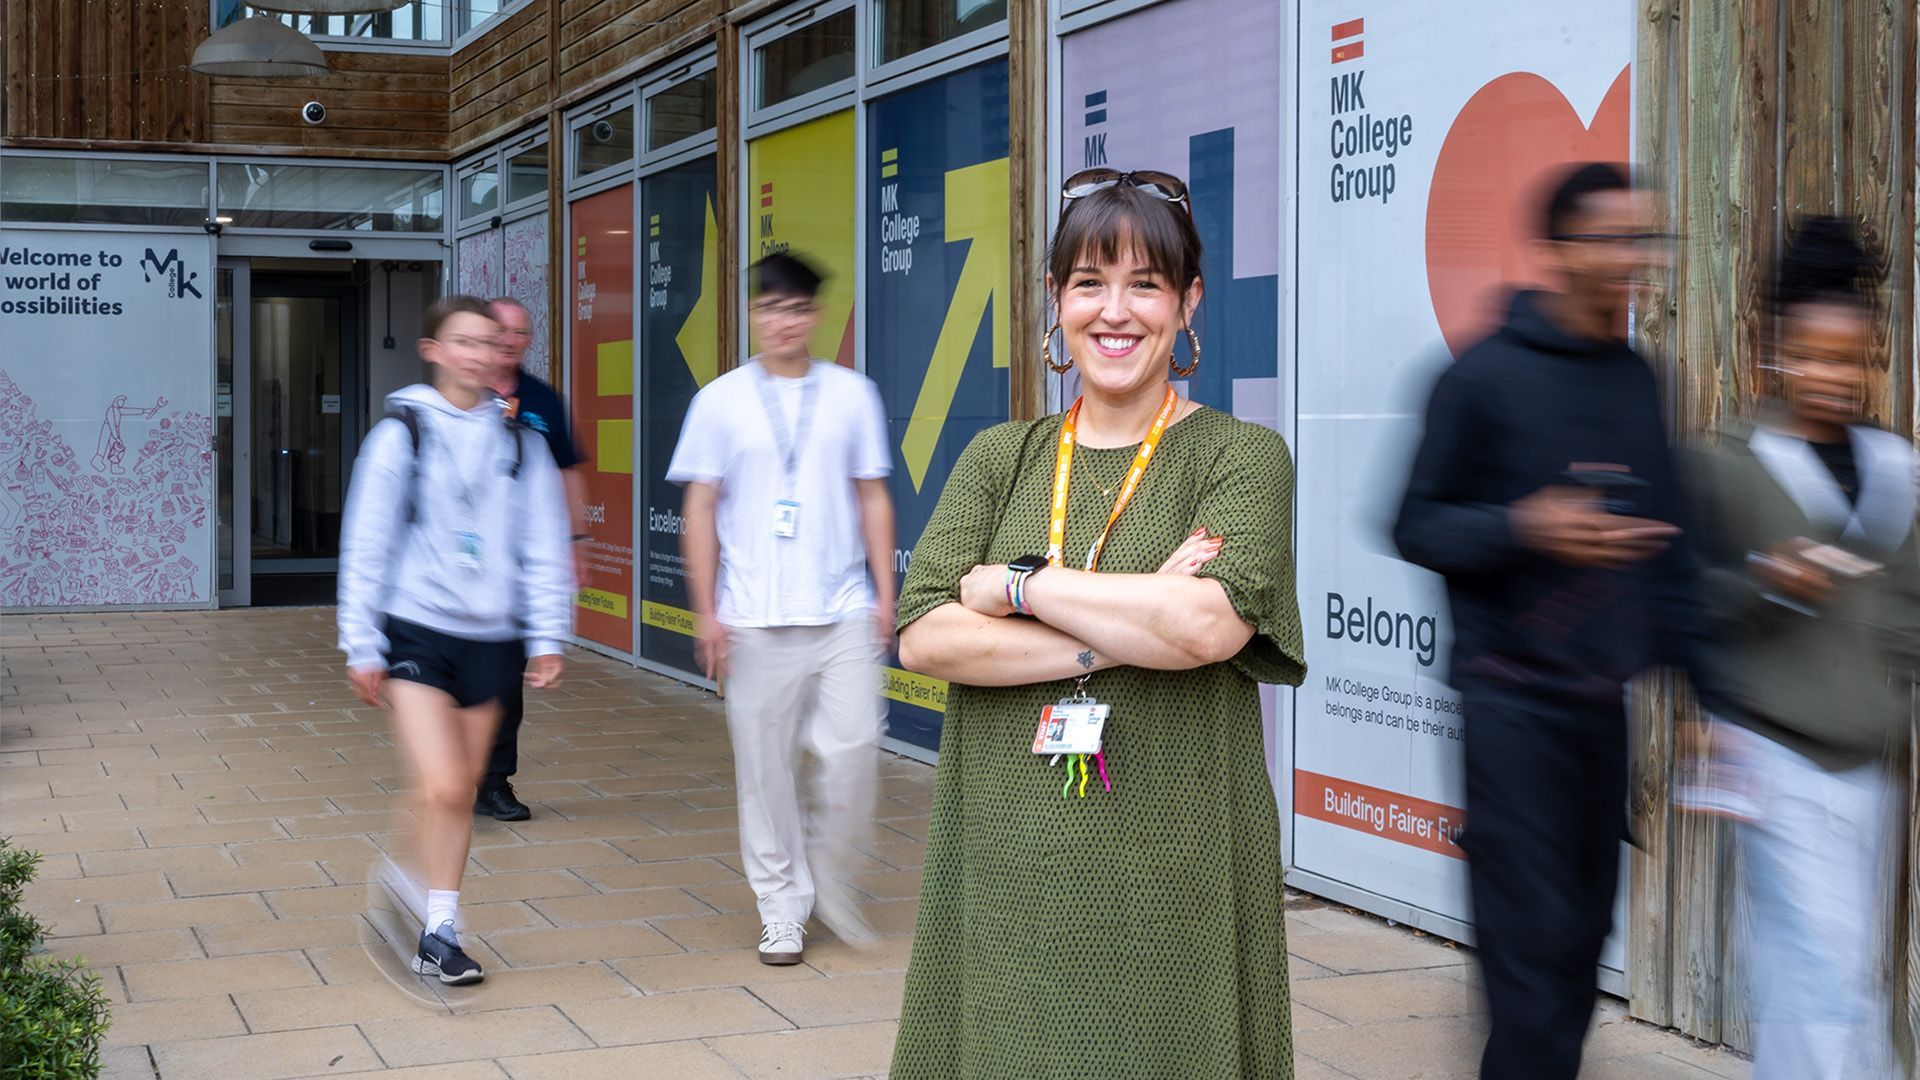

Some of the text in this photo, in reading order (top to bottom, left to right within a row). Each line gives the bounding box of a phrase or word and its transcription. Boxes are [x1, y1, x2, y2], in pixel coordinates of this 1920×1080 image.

[1331, 70, 1365, 116] MK
[1085, 132, 1107, 168] MK
[1330, 113, 1412, 159] College
[881, 183, 899, 214] MK
[1330, 162, 1396, 204] Group
[760, 213, 774, 238] MK
[881, 213, 920, 245] College
[98, 250, 123, 268] to
[881, 246, 912, 276] Group
[5, 272, 101, 291] world of
[168, 267, 176, 299] College
[650, 263, 671, 287] College
[1, 296, 123, 315] ossibilities
[650, 287, 668, 311] Group
[649, 507, 688, 535] Excellenc
[1326, 592, 1437, 667] Belong
[882, 672, 910, 699] Building
[911, 680, 931, 700] Fairer
[1326, 675, 1463, 716] MK College Group is a place
[1325, 700, 1363, 723] belongs
[1365, 710, 1384, 725] and
[1385, 713, 1404, 729] can
[1406, 715, 1419, 732] be
[1422, 718, 1444, 737] their
[1324, 787, 1464, 845] Building Fairer Fut
